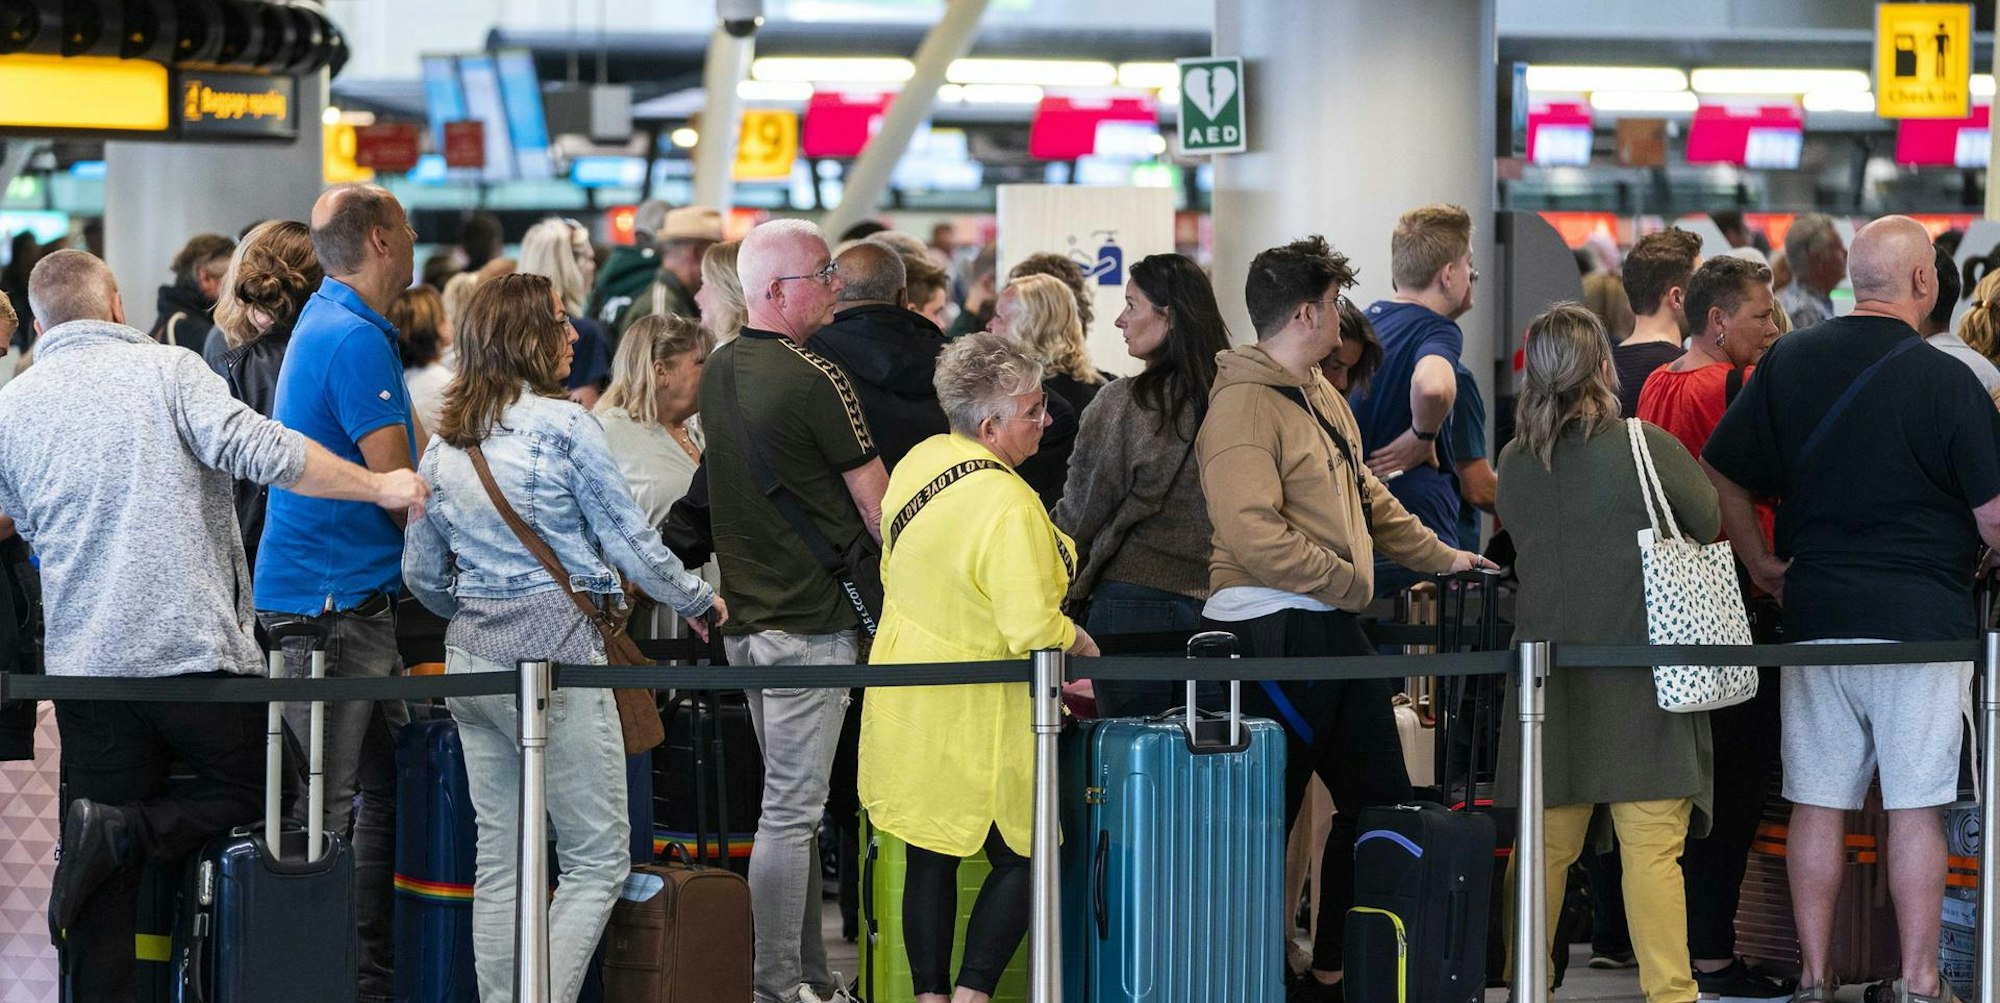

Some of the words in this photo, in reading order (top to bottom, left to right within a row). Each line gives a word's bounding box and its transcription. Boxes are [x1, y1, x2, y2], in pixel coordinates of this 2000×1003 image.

[1889, 89, 1957, 103] Check-in
[1188, 125, 1237, 144] AED
[902, 494, 925, 524] LOVE
[924, 470, 955, 500] LOVE
[843, 582, 866, 611] SCOTT
[863, 616, 877, 637] YLE
